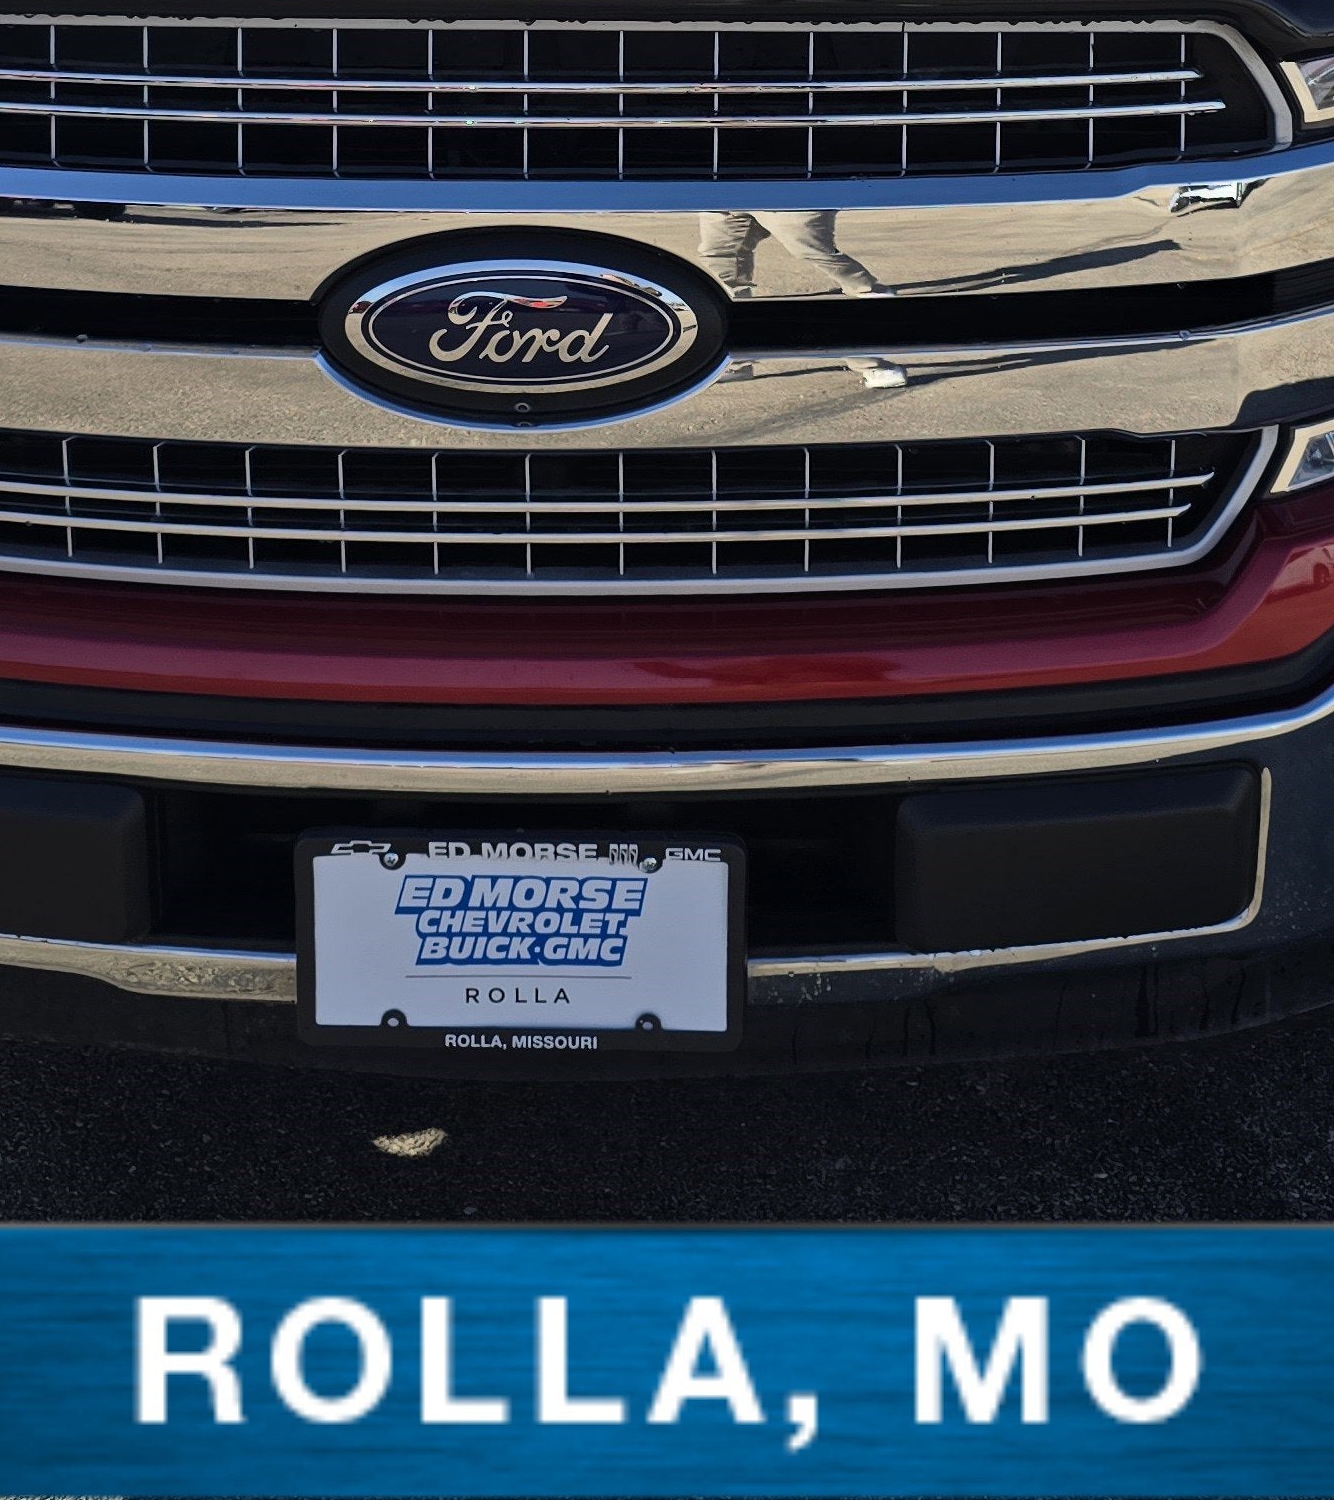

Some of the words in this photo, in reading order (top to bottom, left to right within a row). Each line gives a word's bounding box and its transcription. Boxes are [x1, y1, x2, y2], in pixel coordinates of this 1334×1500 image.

[429, 291, 615, 363] Ford
[428, 841, 471, 861] ED
[481, 842, 598, 862] MORSE
[665, 847, 722, 862] GMC
[398, 876, 466, 908] ED
[467, 877, 646, 911] MORSE
[418, 909, 626, 935] CHEVROLET
[465, 987, 570, 1004] ROLLA
[444, 1034, 507, 1050] ROLLA,
[511, 1035, 598, 1050] MISSOURI
